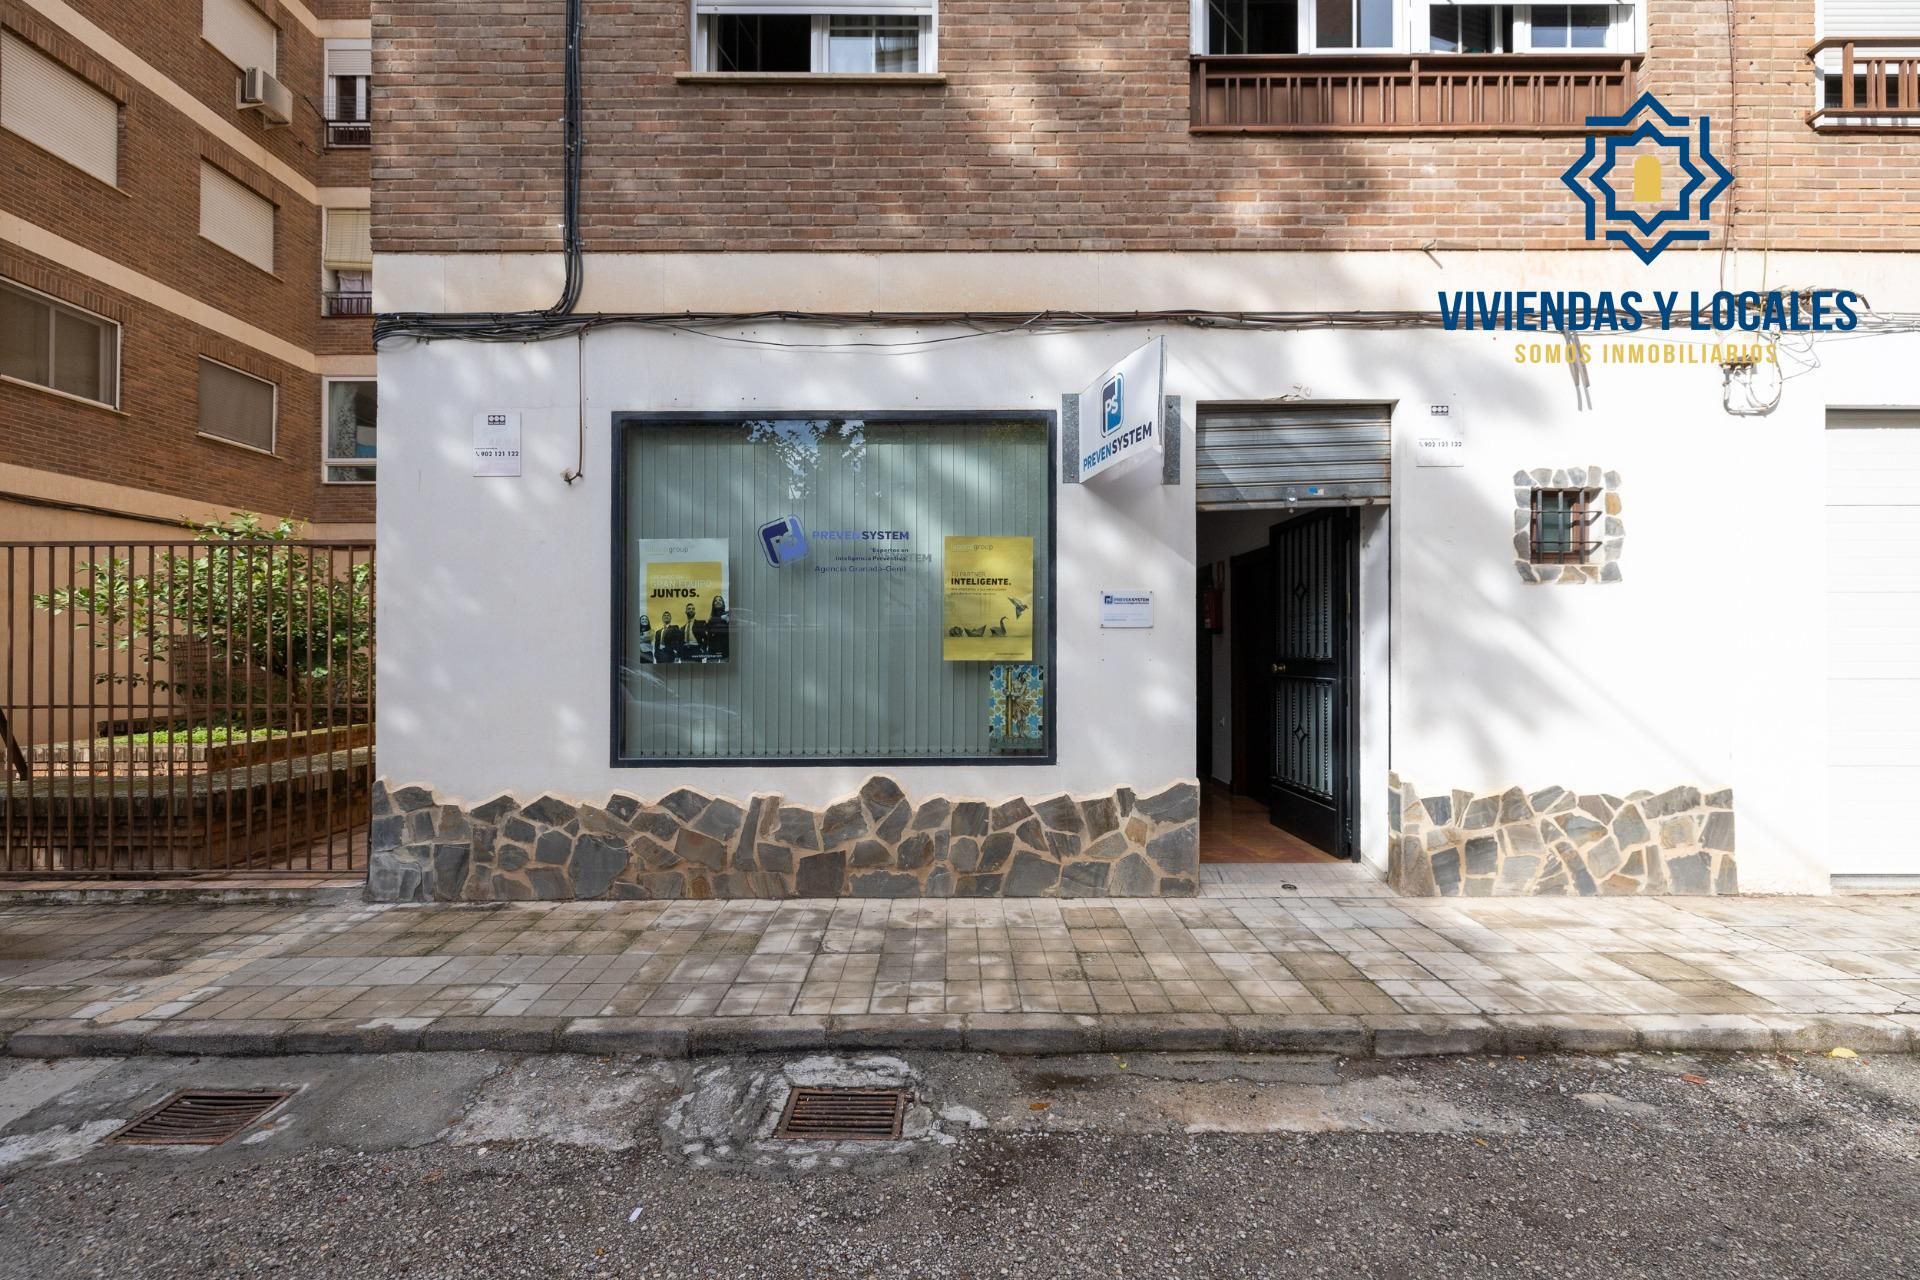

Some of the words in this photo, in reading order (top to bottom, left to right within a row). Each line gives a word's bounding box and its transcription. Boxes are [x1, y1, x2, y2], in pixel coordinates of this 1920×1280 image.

[1082, 421, 1153, 473] PREVENSYSTEM
[812, 530, 910, 541] PREVENSYSTEM
[815, 565, 847, 574] Agencia
[951, 578, 1012, 586] INTELIGENTE.
[650, 588, 700, 598] JUNTOS.
